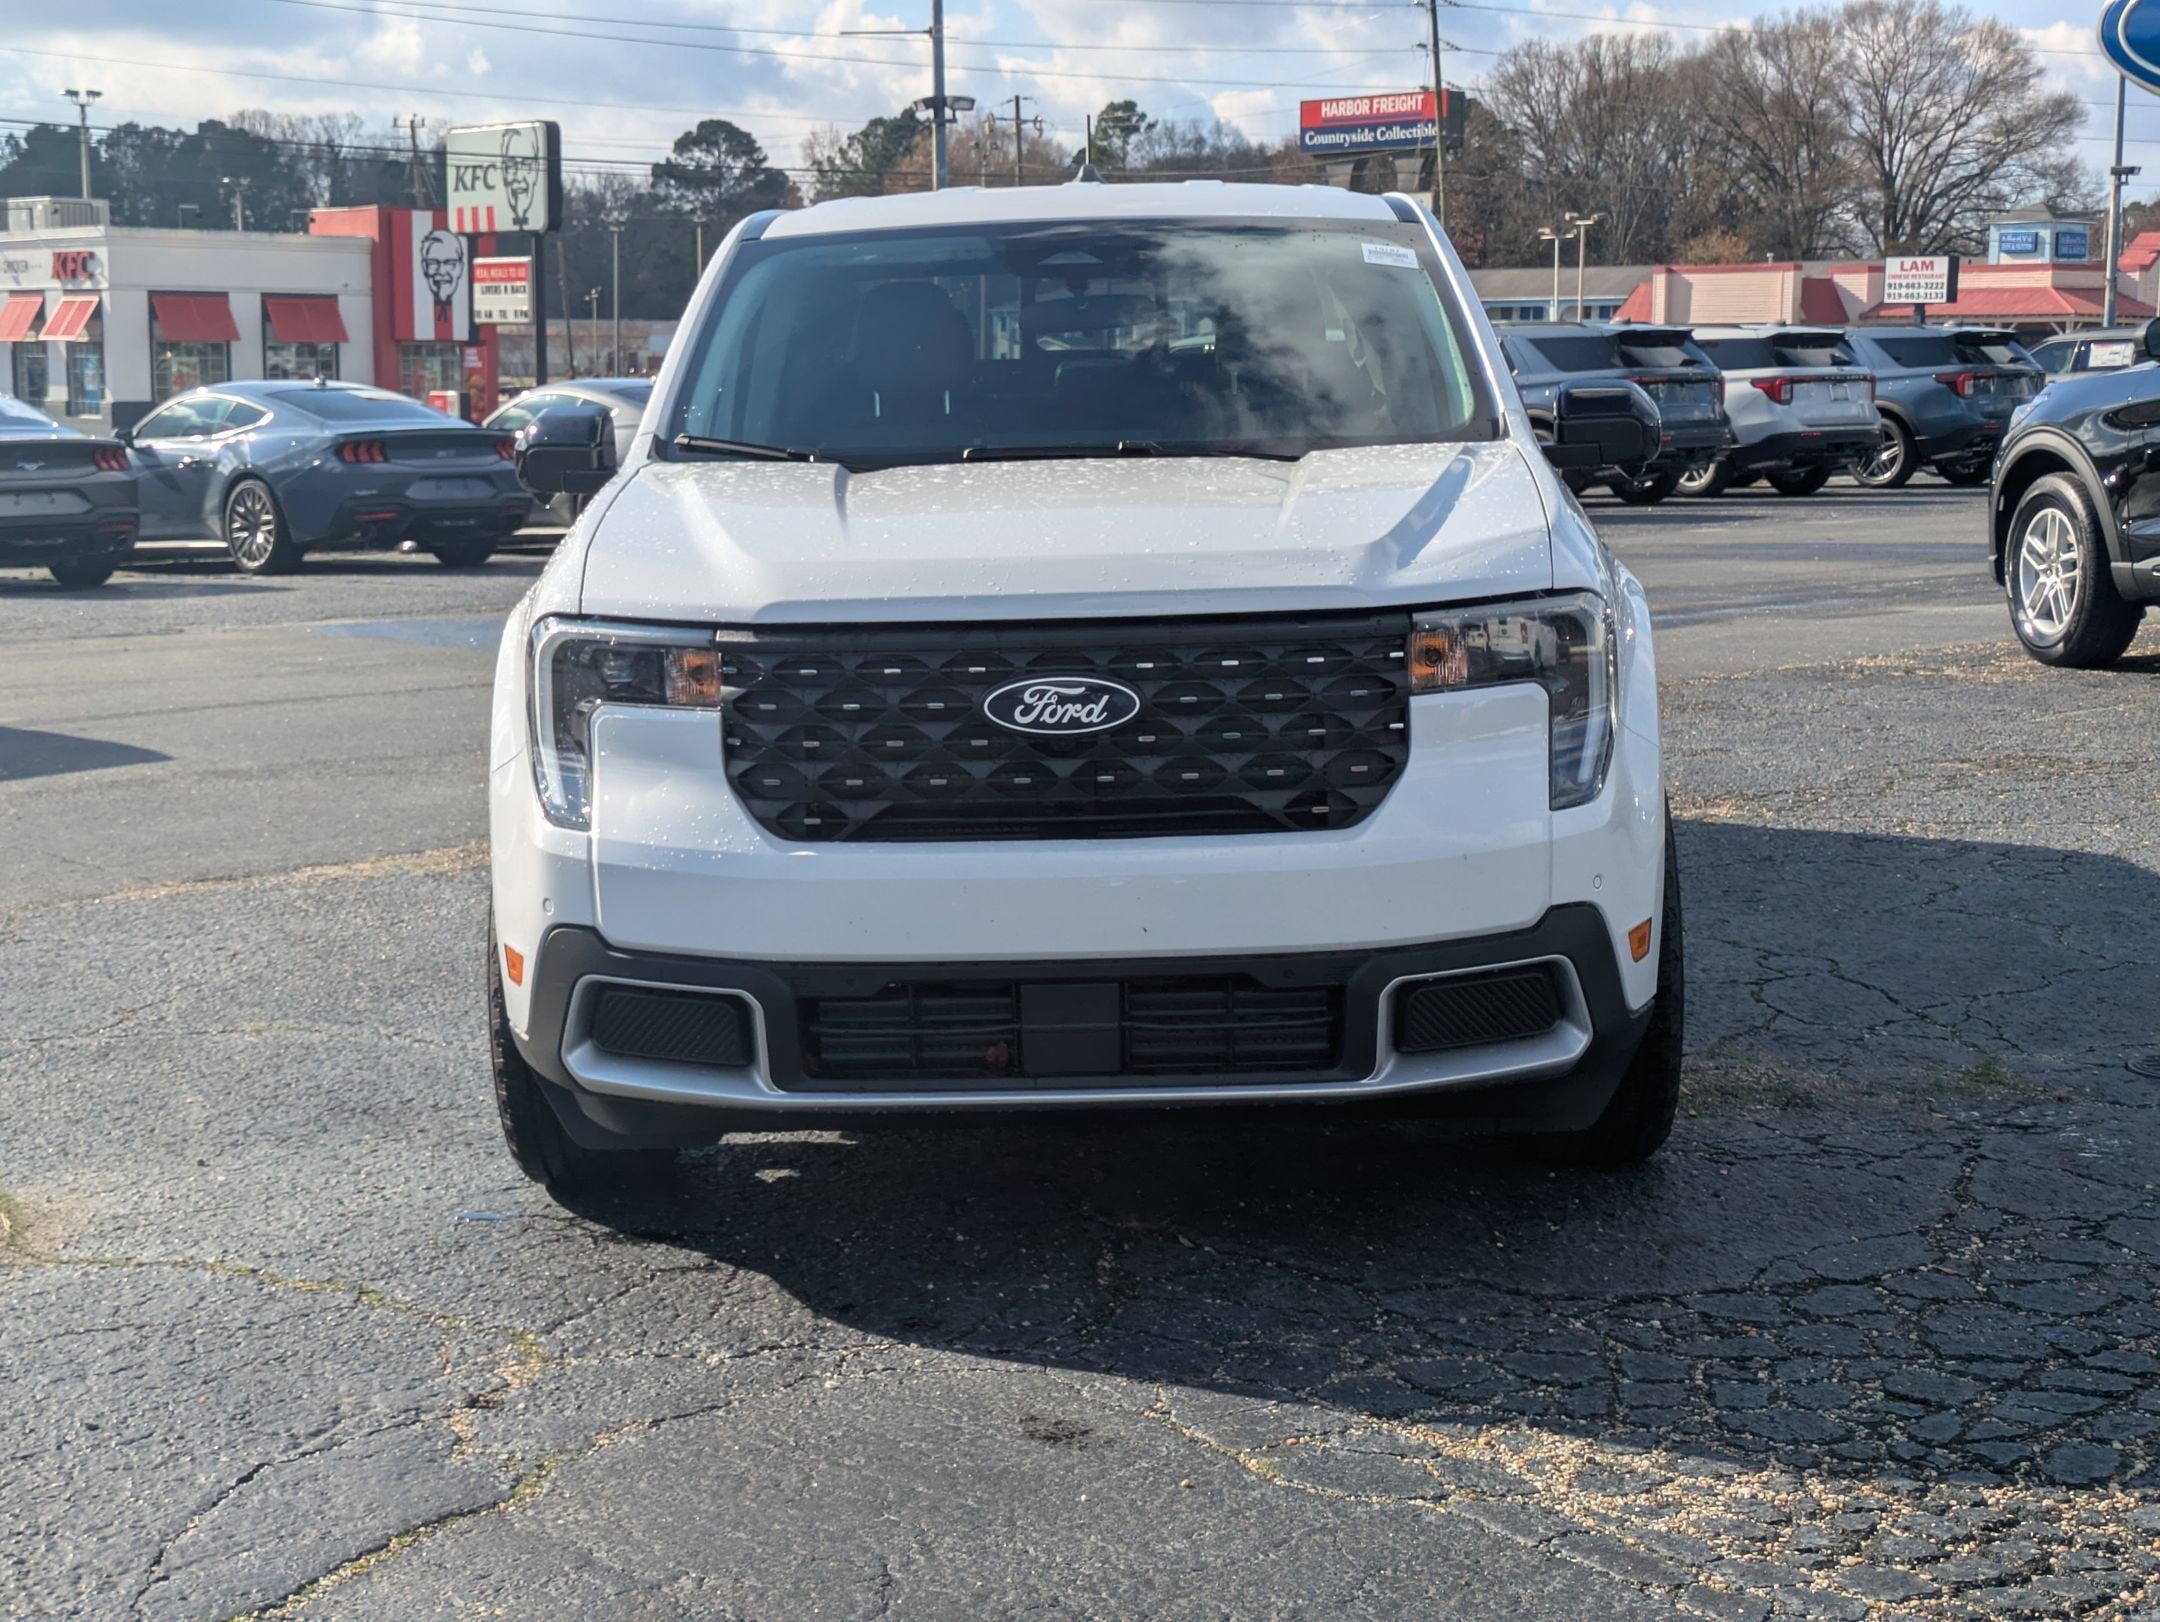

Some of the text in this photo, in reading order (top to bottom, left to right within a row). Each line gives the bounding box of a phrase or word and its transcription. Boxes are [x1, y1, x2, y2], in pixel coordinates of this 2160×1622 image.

[1321, 95, 1424, 118] HARBOR FREIGHT
[1305, 121, 1440, 147] Countryside Collectible
[453, 163, 497, 192] KFC
[51, 250, 95, 279] KFC
[1900, 260, 1935, 272] LAM
[1887, 282, 1945, 290] 919-663-3222
[1014, 685, 1110, 724] Ford
